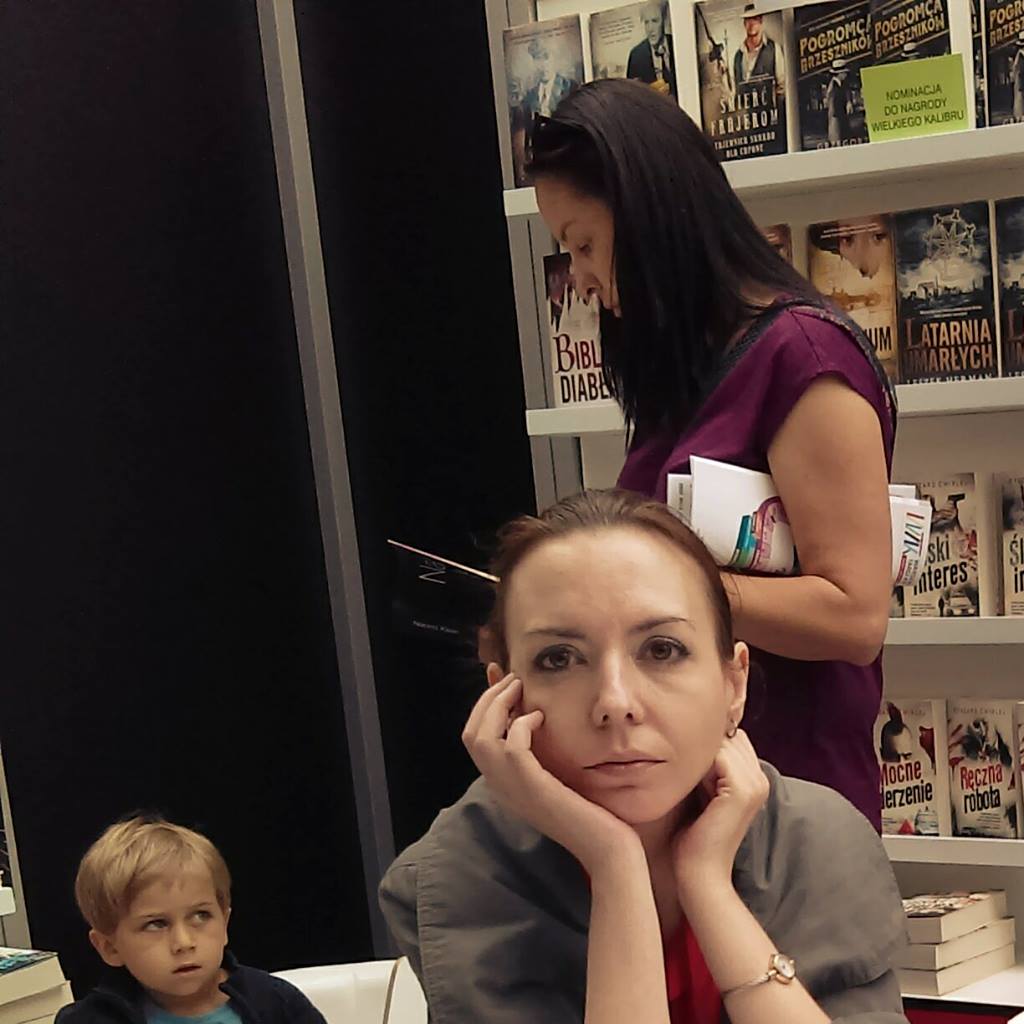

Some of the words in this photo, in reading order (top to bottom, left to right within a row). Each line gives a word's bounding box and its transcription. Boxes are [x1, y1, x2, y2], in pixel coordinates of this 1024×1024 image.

[886, 84, 942, 101] NOMINACJA
[884, 103, 899, 116] DO
[901, 98, 947, 114] NAGRODY
[871, 117, 924, 133] WIELKIEGO
[925, 110, 964, 125] KALIBRU
[903, 317, 992, 349] LATARNIA
[903, 342, 993, 374] UMARŁYCH
[959, 763, 1003, 791] Ręczna
[963, 785, 1001, 814] robota
